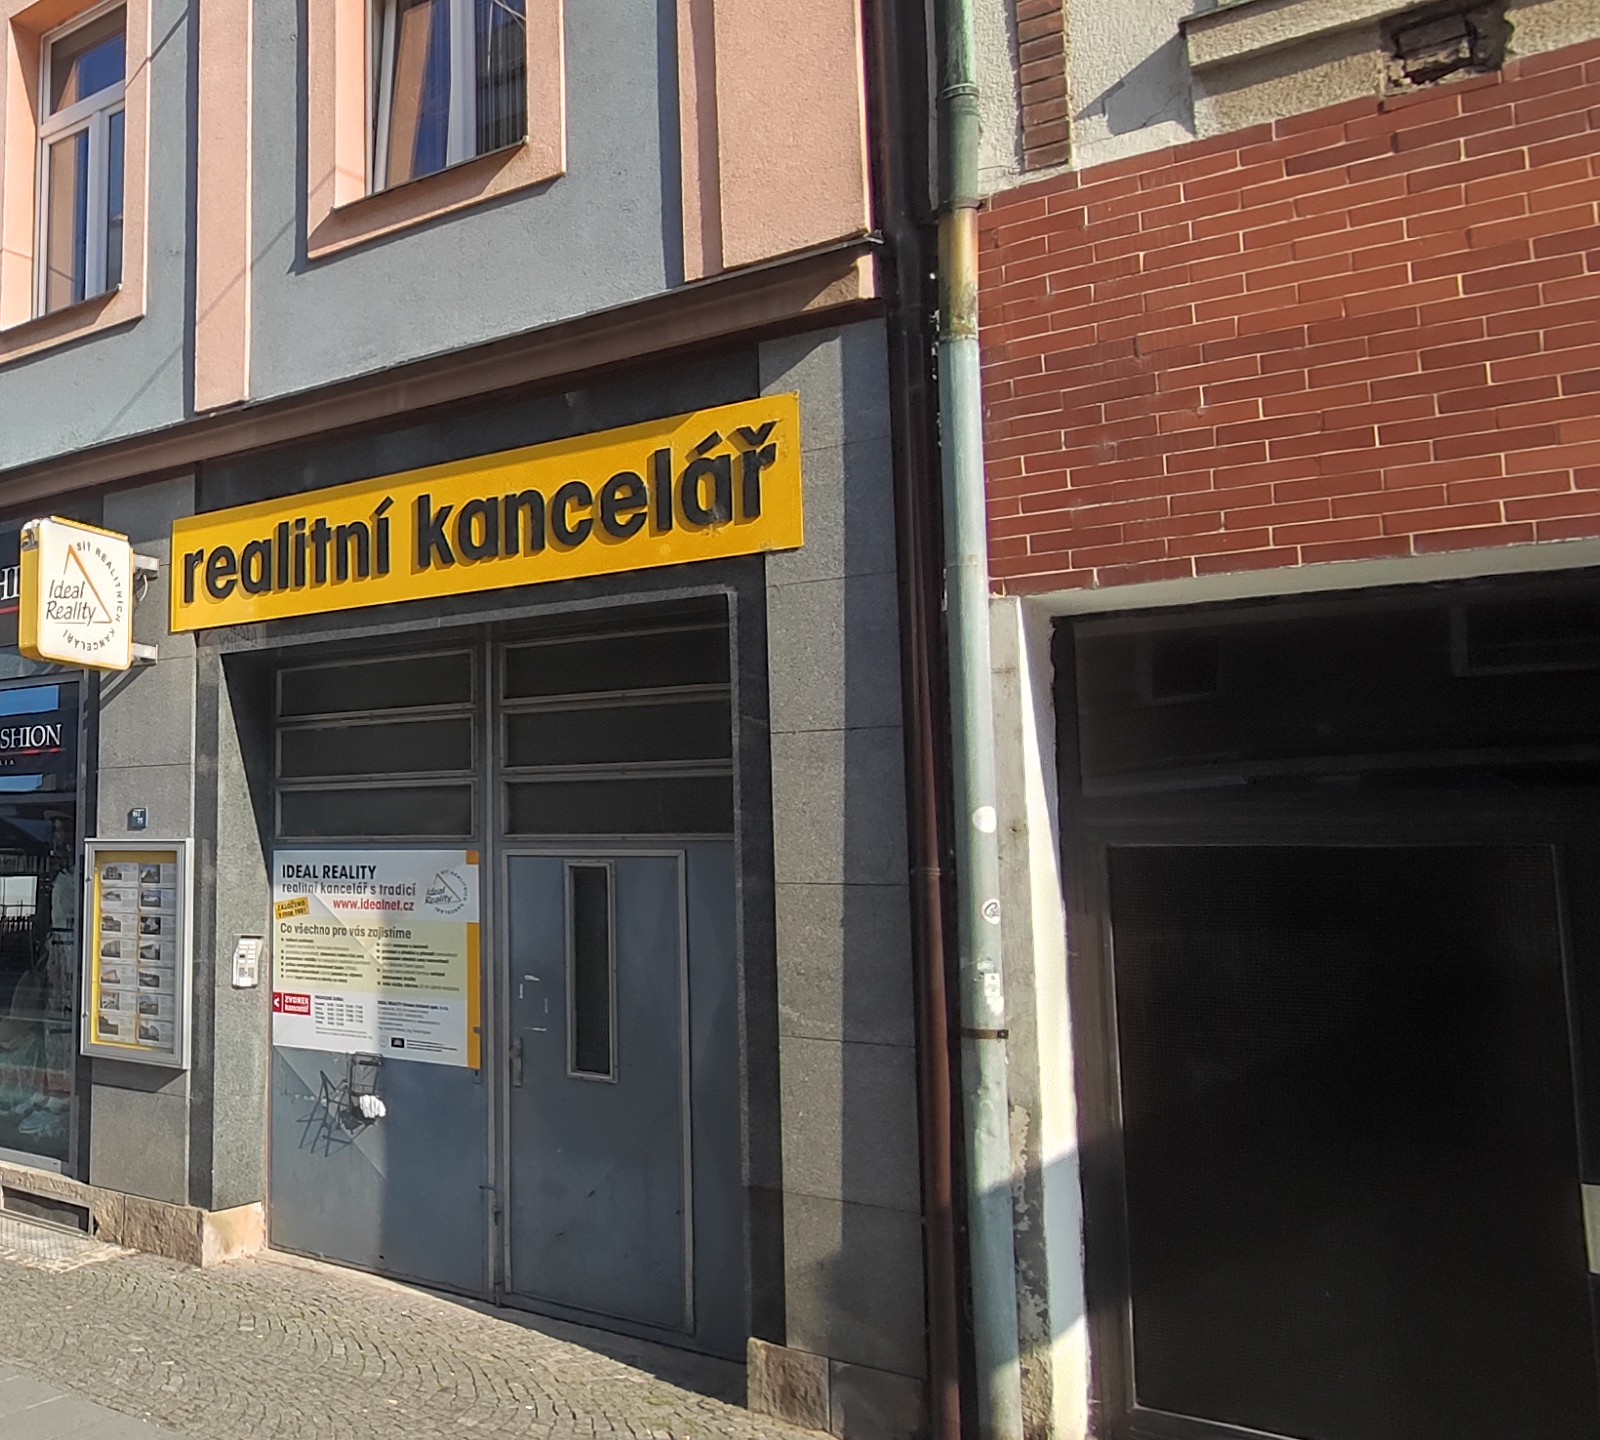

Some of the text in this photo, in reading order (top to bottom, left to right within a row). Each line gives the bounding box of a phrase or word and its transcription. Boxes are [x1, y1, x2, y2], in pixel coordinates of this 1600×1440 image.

[182, 422, 778, 603] realitní kancelář
[49, 579, 85, 599] Ideal
[282, 864, 377, 880] IDEAL REALITY
[282, 881, 417, 896] realitní kancelář s tradicí
[332, 898, 415, 911] www.idealnet.cz
[280, 922, 412, 939] Co všechno pro vás zajistíme
